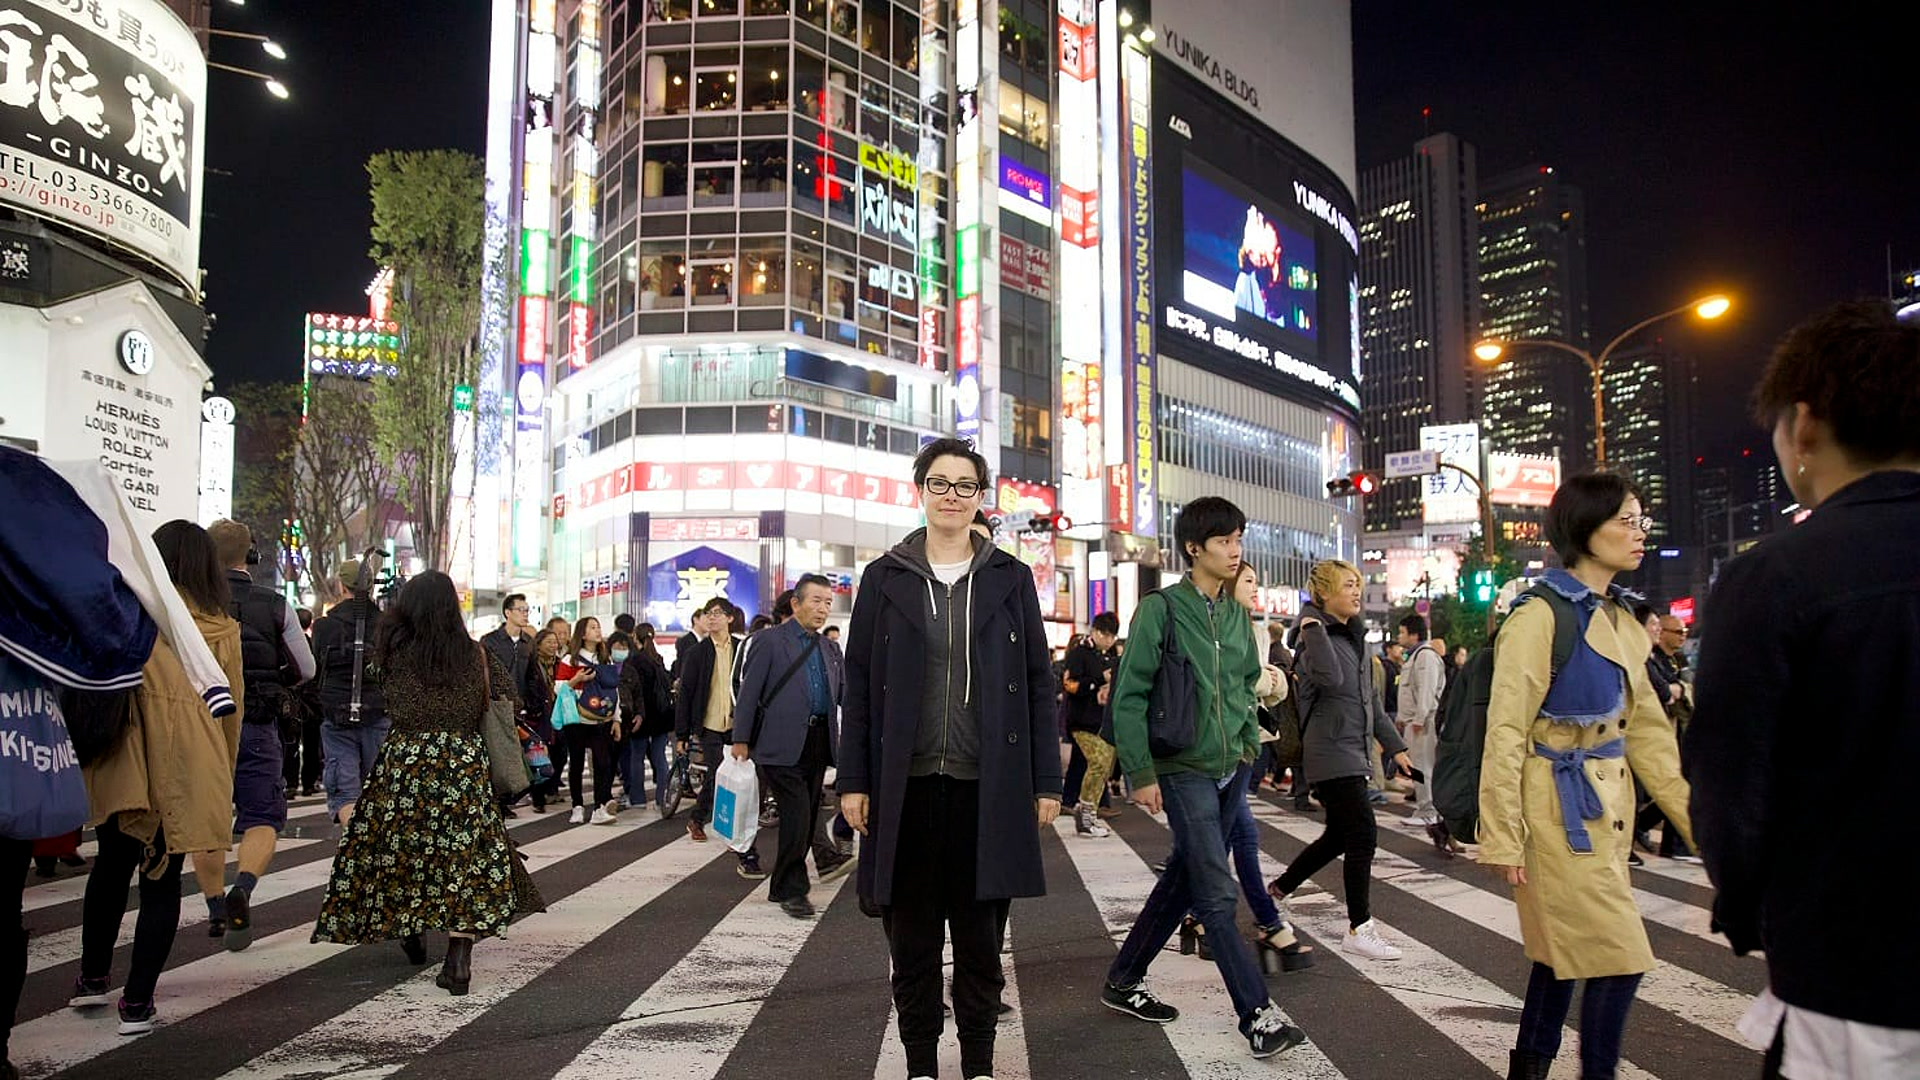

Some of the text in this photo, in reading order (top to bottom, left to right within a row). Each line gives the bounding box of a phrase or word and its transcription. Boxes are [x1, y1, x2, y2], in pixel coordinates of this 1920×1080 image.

[1163, 24, 1262, 111] YUNIKA BLDG.
[325, 314, 387, 333] オカダヤ
[96, 400, 161, 430] HERMÈS
[84, 415, 169, 450] LOUIS VUITTON
[102, 437, 153, 462] ROLEX
[100, 455, 155, 479] Cartier
[795, 465, 914, 507] アイフル
[1429, 471, 1478, 495] 鉄人
[1127, 993, 1148, 1009] N
[1253, 1033, 1264, 1050] N
